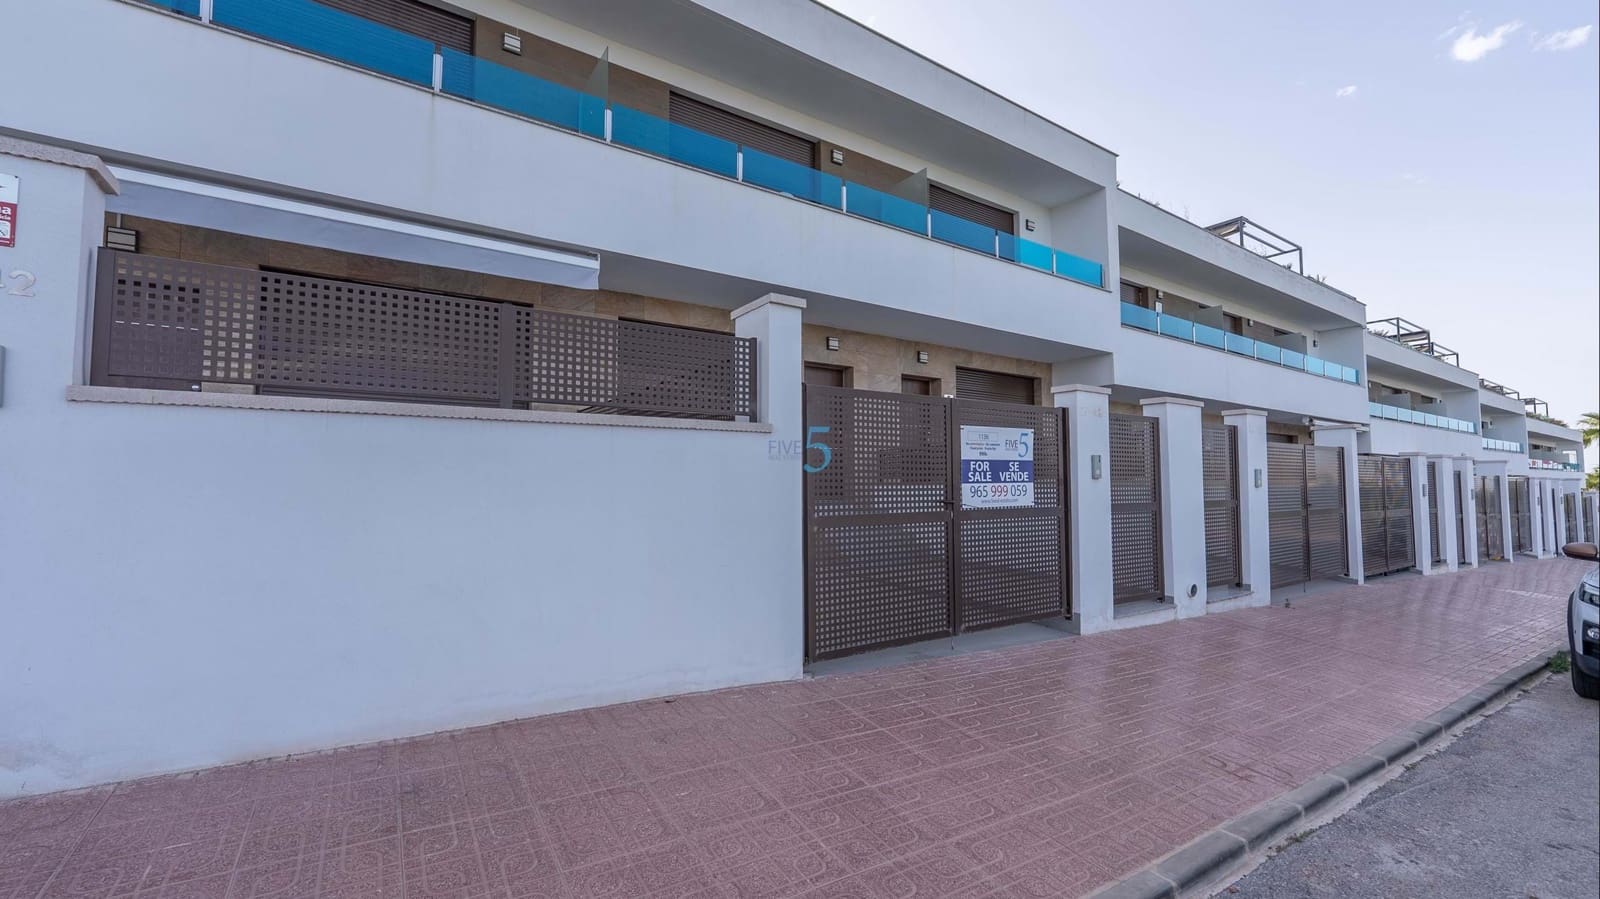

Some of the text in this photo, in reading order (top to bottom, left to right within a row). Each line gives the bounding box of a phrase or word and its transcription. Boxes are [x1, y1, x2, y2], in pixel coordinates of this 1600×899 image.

[1005, 432, 1029, 458] FIVE 5
[970, 461, 1020, 472] FOR SE
[968, 471, 1029, 482] SALE VENDE
[969, 484, 1028, 498] 965 999 059
